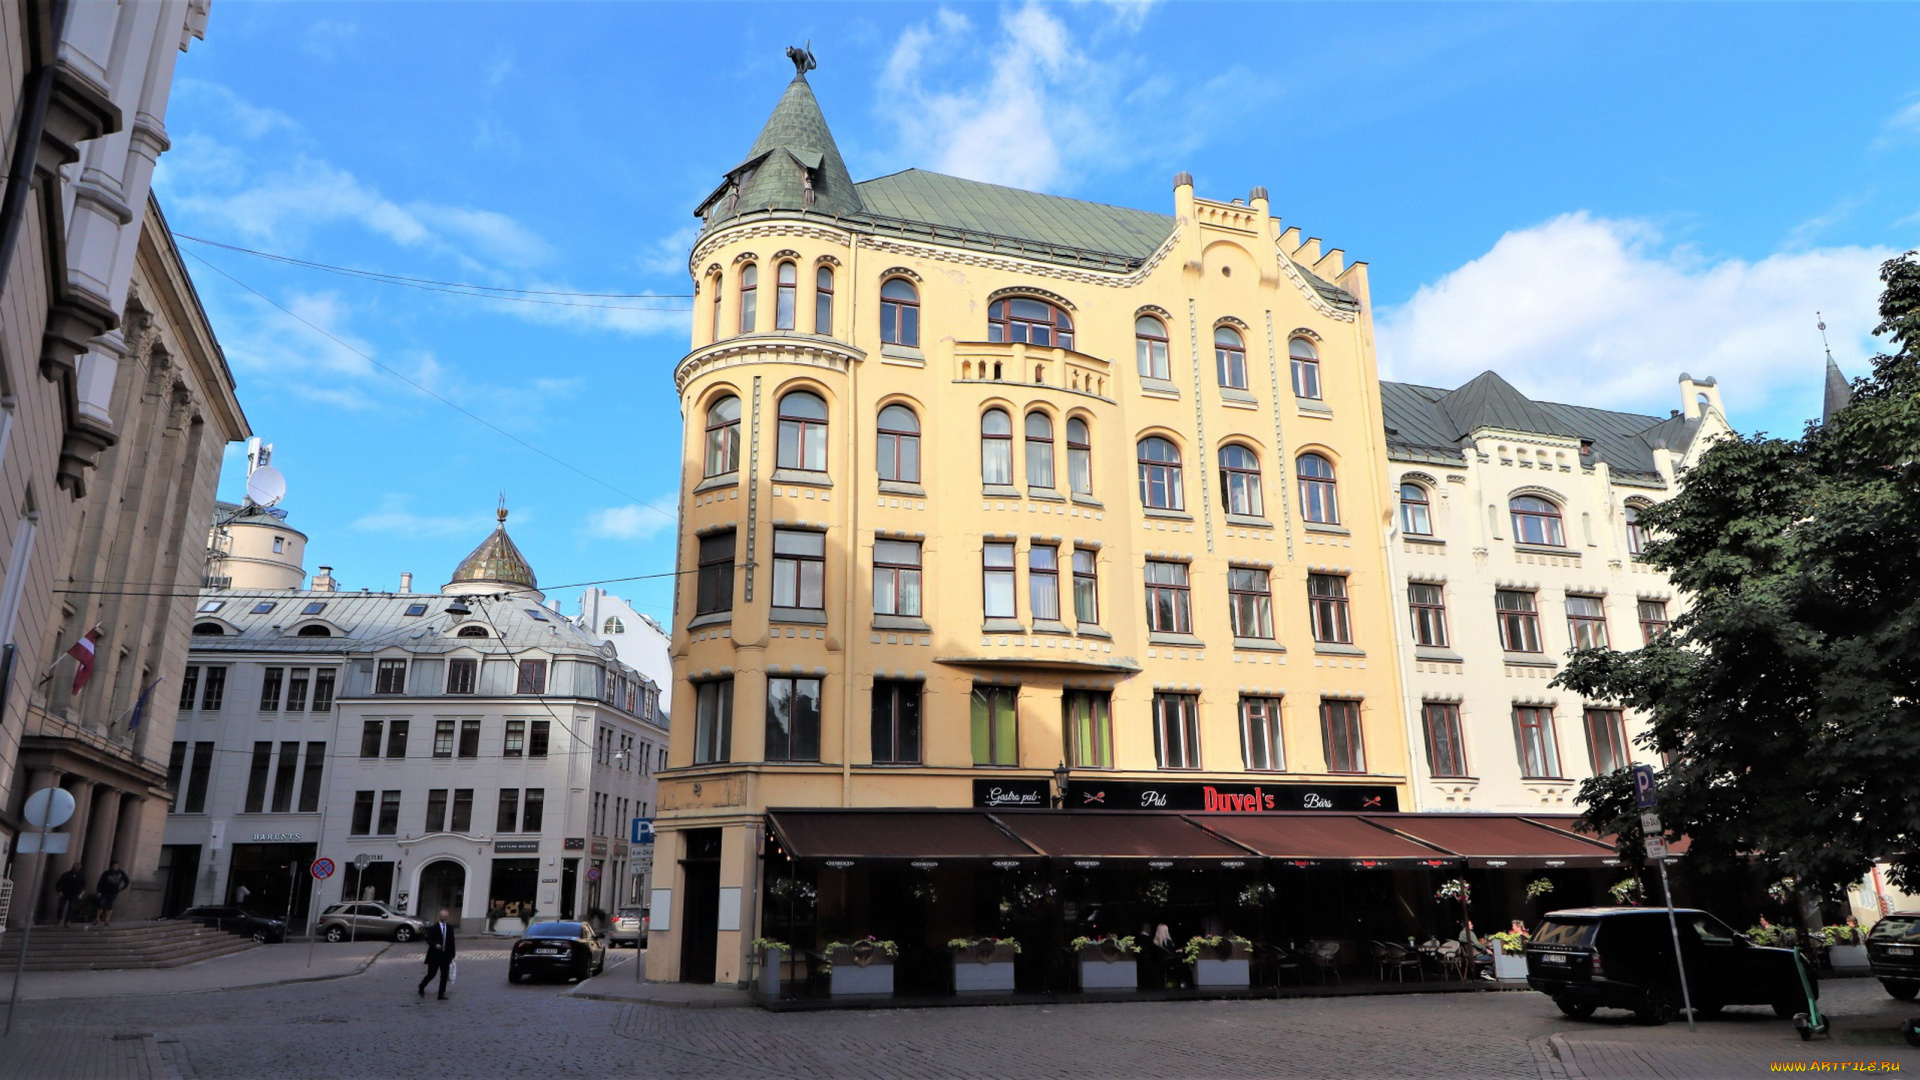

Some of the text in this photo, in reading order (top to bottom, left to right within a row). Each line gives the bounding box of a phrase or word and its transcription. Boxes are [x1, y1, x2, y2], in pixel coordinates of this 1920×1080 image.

[989, 787, 1037, 806] Gastro pub
[1141, 790, 1167, 807] Pub
[1202, 785, 1275, 812] Duvel's
[637, 821, 654, 841] P
